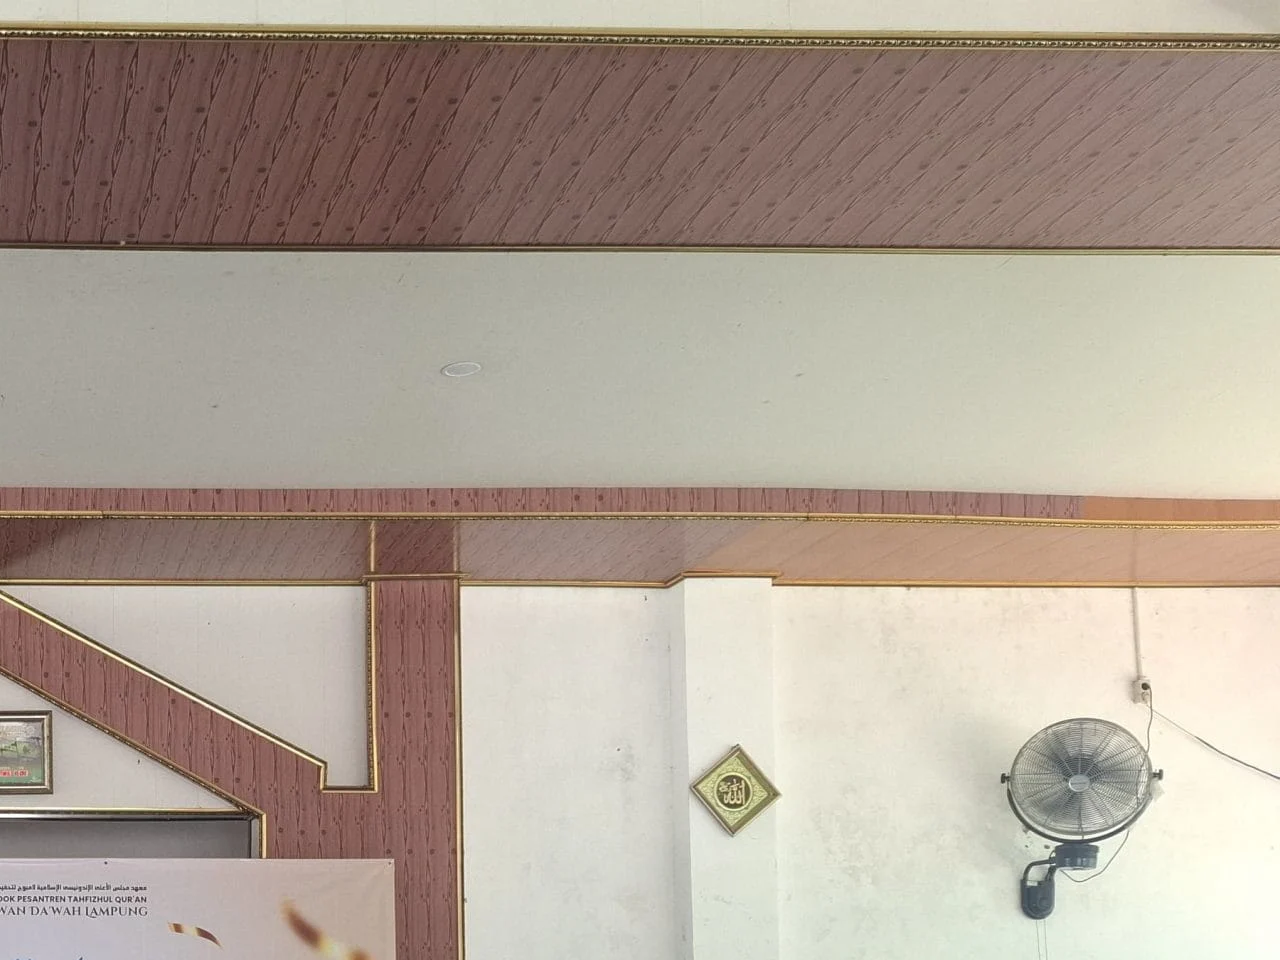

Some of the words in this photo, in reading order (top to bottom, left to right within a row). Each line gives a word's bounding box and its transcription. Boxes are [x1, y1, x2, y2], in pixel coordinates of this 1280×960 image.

[114, 895, 147, 903] QUR'AN
[29, 905, 81, 916] DA'WAH
[85, 906, 148, 919] LAMPUNG
